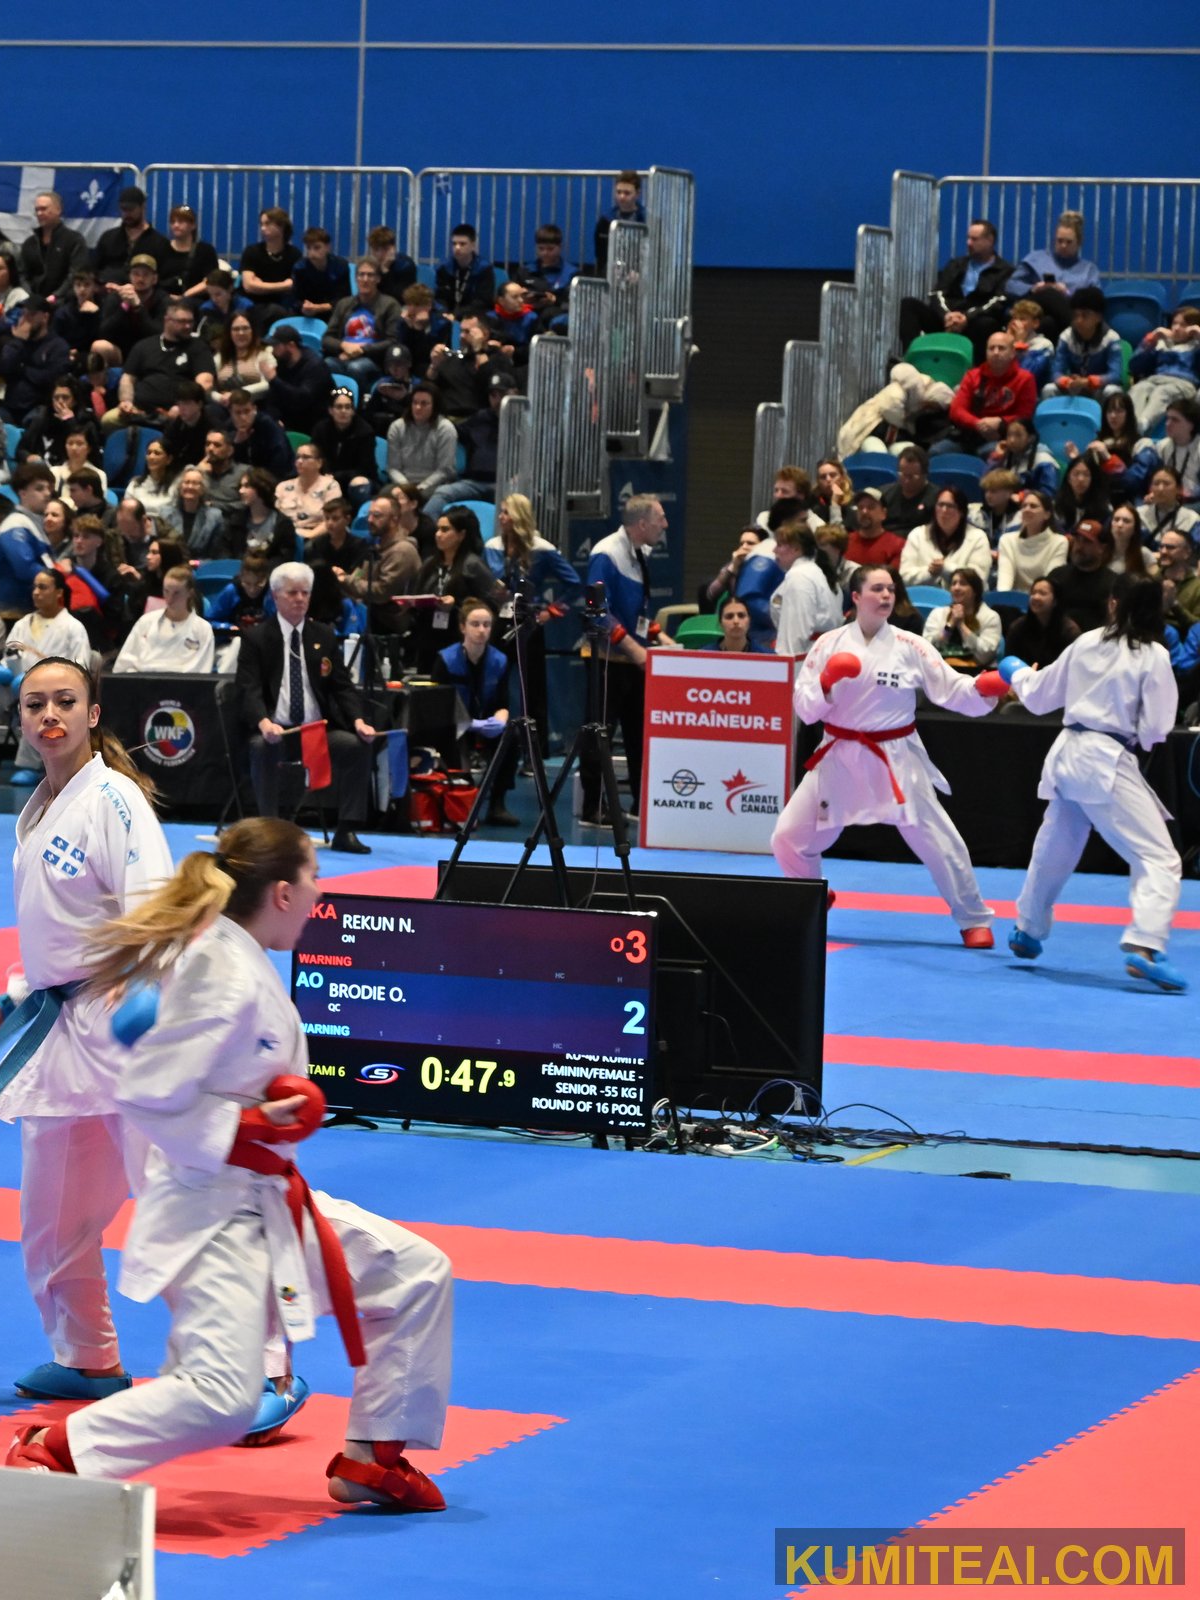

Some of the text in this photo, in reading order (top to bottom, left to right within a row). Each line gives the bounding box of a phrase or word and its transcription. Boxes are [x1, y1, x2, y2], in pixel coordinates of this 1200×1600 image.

[686, 688, 751, 705] COACH
[154, 725, 184, 740] WKF
[653, 798, 713, 810] KARATE BC
[741, 794, 779, 805] KARATE
[740, 804, 780, 815] CANADA
[342, 914, 416, 934] REKUN N.
[341, 934, 356, 943] ON
[298, 953, 353, 967] WARNING
[295, 971, 324, 989] AO
[555, 971, 565, 979] HC
[328, 982, 407, 1003] BRODIE O.
[327, 1003, 341, 1012] QC
[622, 1000, 645, 1035] 2
[553, 1042, 563, 1050] HC
[304, 1063, 346, 1077] TAMI 6
[421, 1056, 516, 1094] 0:47.9
[541, 1062, 636, 1082] FÉMININ/FEMALE
[555, 1082, 598, 1096] SENIOR
[599, 1085, 619, 1098] -55
[620, 1086, 638, 1099] KG
[531, 1097, 644, 1117] ROUND OF 16 POOL
